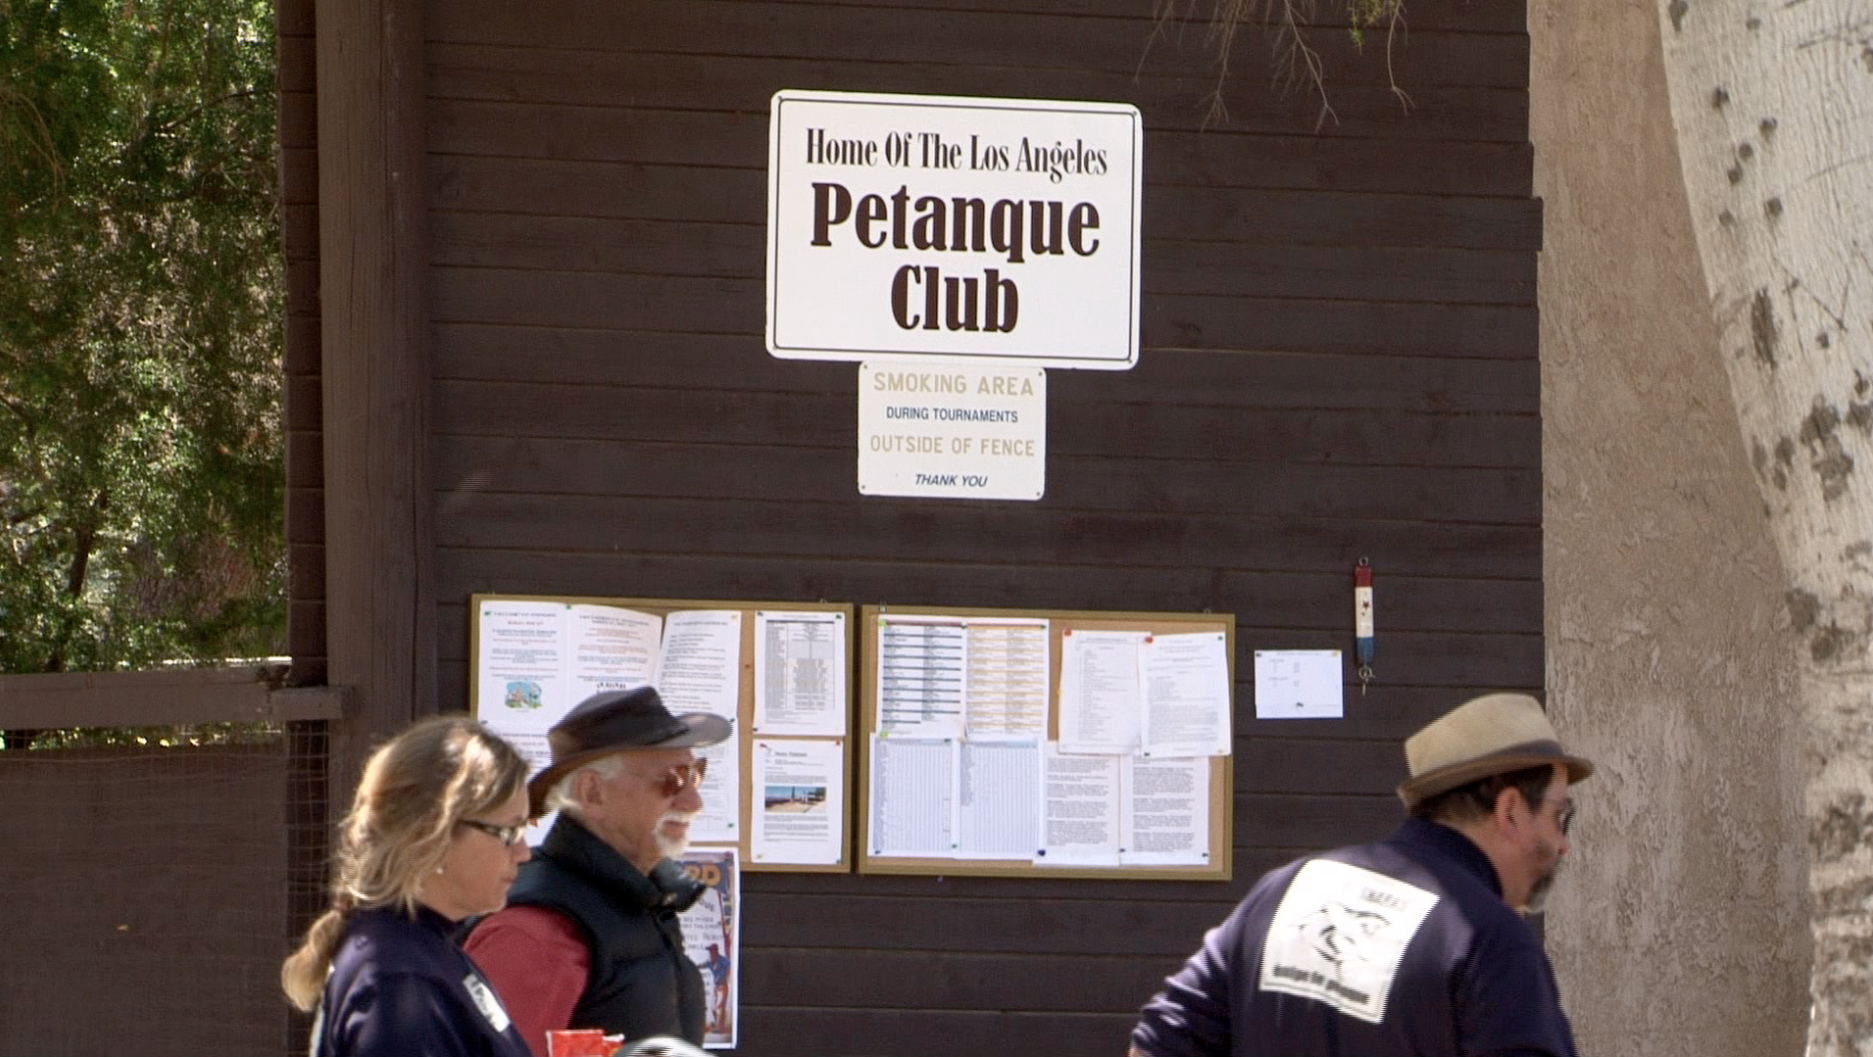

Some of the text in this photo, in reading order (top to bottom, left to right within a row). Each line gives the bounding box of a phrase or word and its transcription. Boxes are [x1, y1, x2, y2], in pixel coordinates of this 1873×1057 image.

[806, 128, 1108, 184] Home Of The Los Angeles
[810, 181, 1100, 263] Petanque
[890, 264, 1019, 333] Club
[874, 372, 1033, 396] SMOKING AREA
[887, 407, 1018, 423] DURING TOURNAMENTS
[871, 435, 1034, 456] OUTSIDE OF FENCE
[916, 474, 988, 487] THANK YOU
